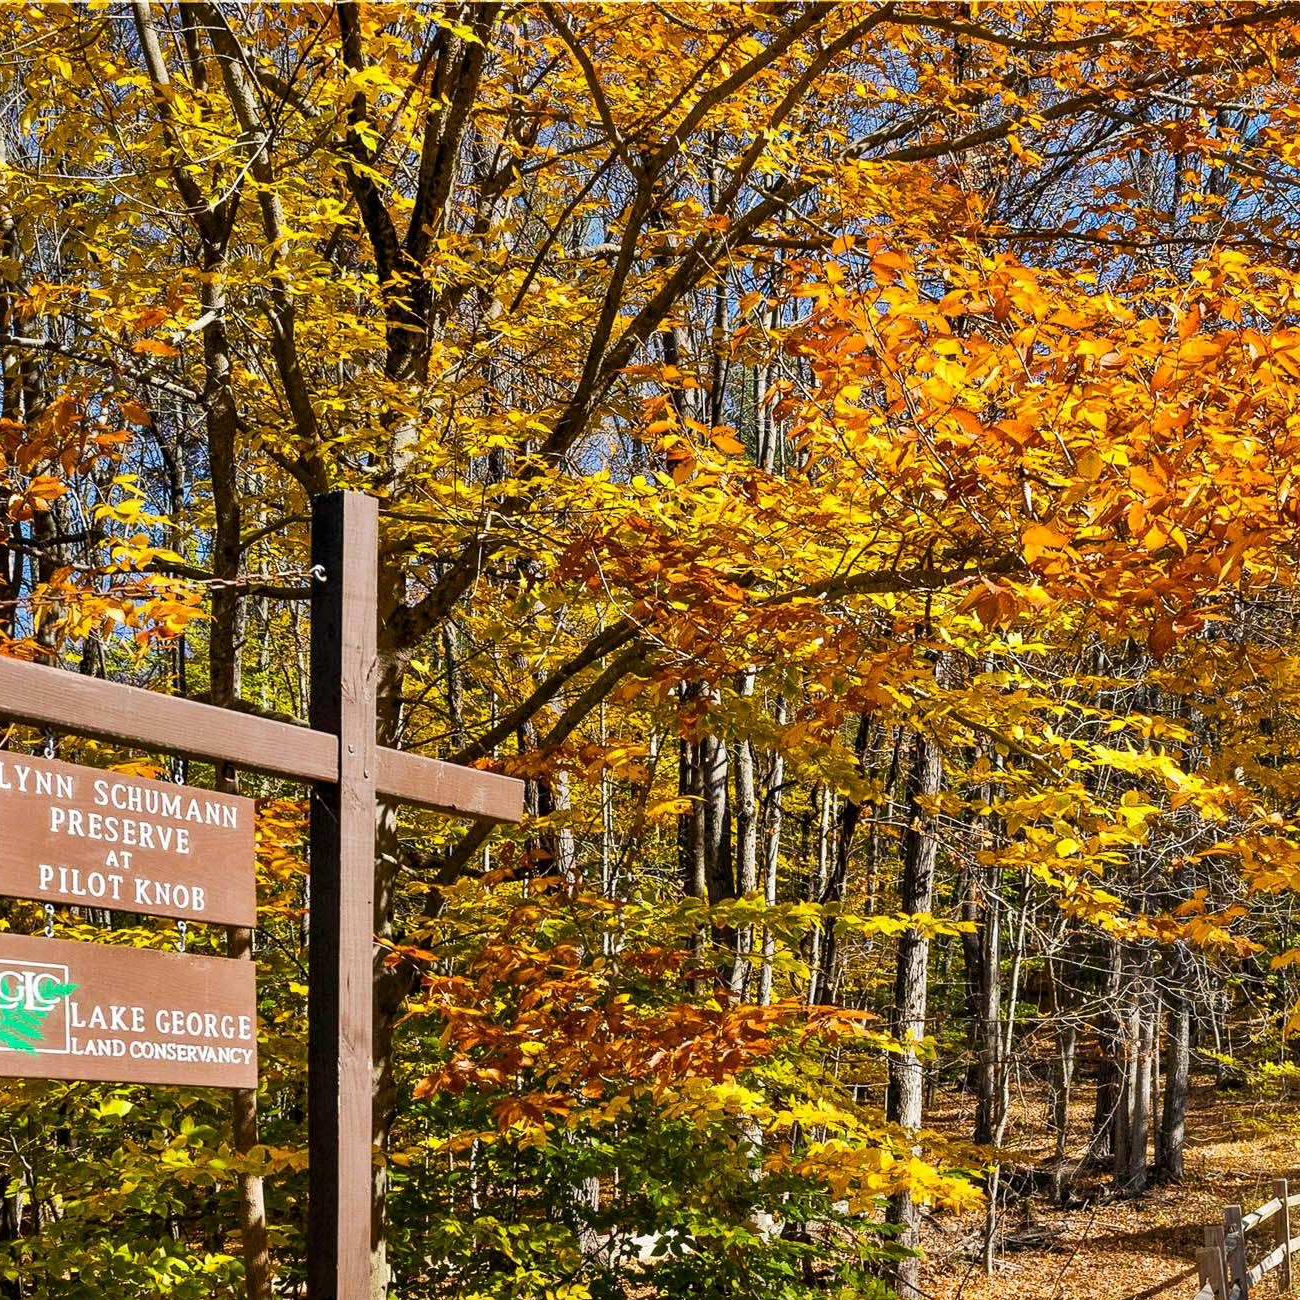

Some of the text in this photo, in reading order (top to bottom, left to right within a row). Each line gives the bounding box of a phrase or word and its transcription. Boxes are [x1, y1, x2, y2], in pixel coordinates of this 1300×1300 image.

[93, 779, 238, 829] SCHUMANN
[49, 806, 190, 855] PRESERVE
[105, 849, 133, 870] AT
[38, 863, 206, 912] PILOT KNOB
[71, 1001, 252, 1041] LAKE GEORGE
[71, 1036, 254, 1065] LAND CONSERVANCY
